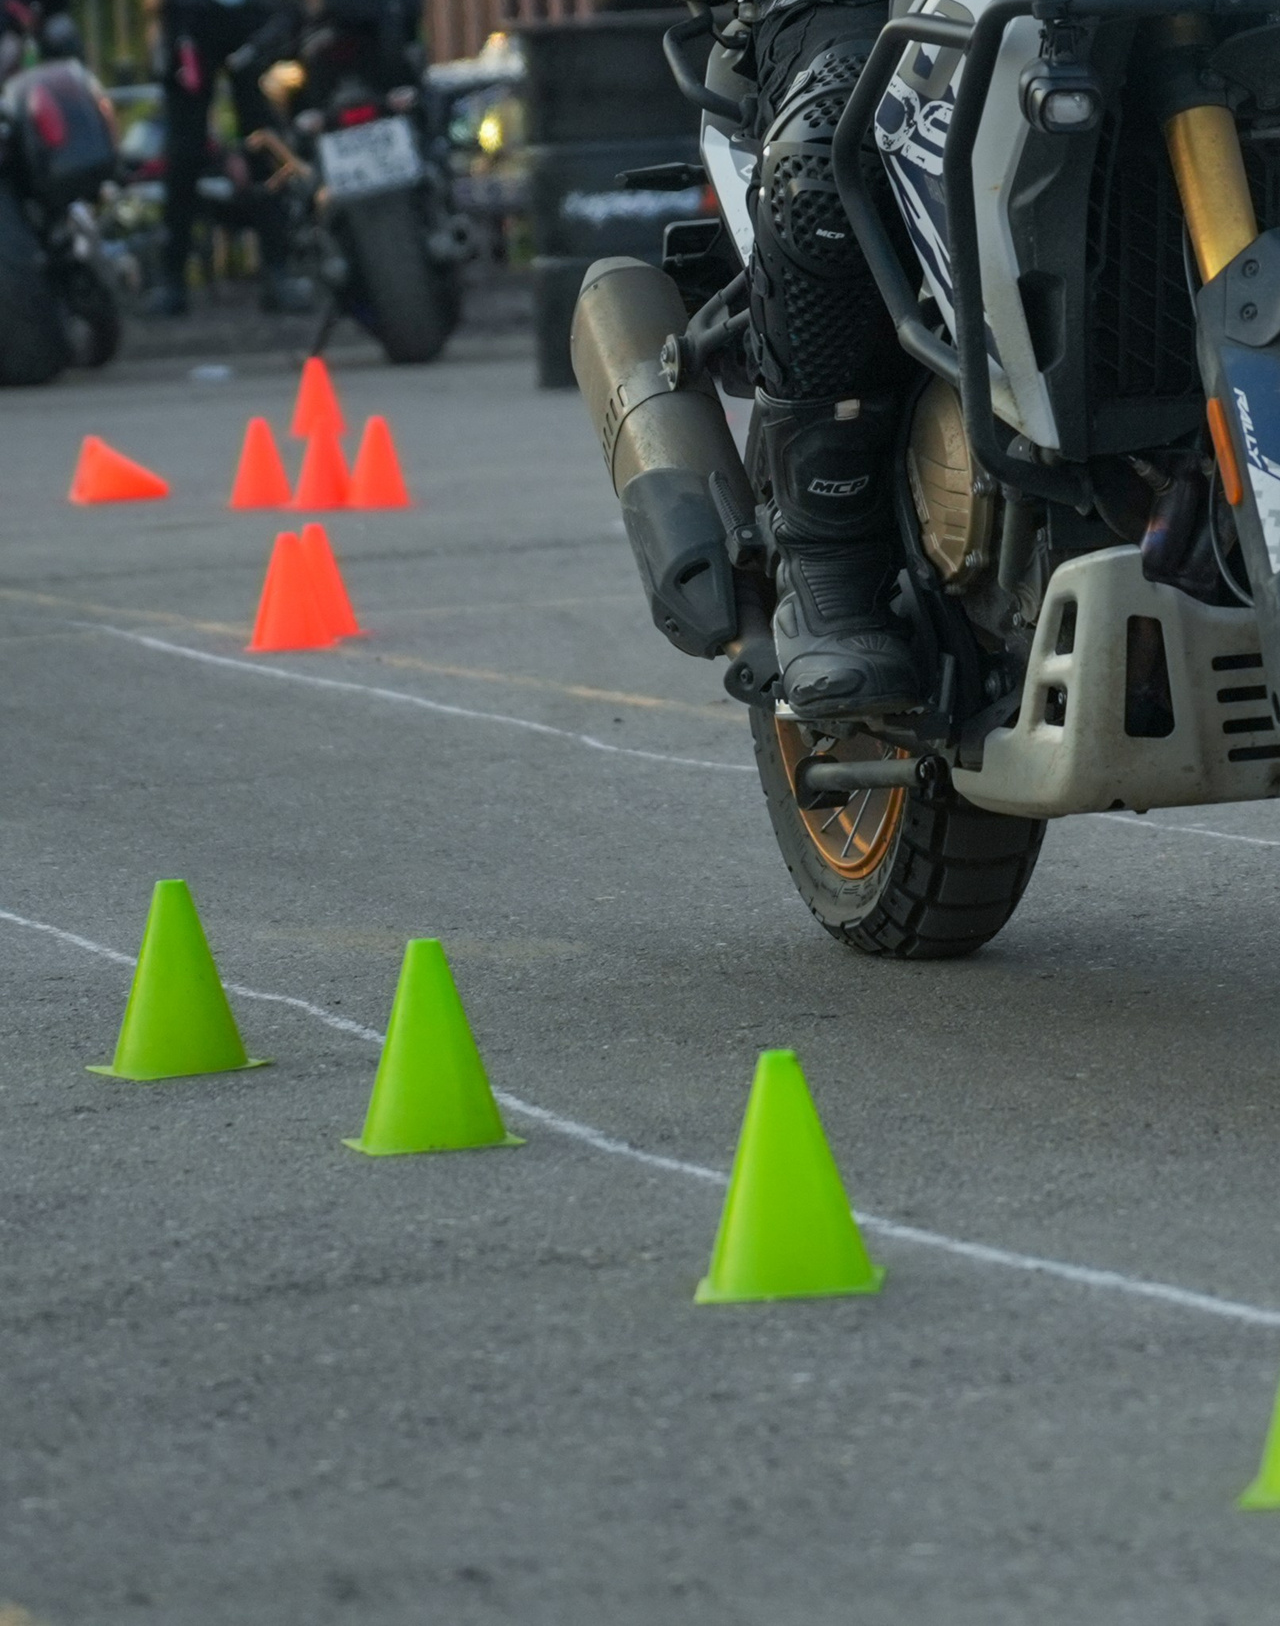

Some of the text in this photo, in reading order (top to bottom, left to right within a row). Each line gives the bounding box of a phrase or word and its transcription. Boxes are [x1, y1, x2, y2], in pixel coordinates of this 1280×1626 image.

[815, 228, 845, 240] MCP
[1233, 387, 1263, 469] RALLY
[808, 476, 869, 496] MCP
